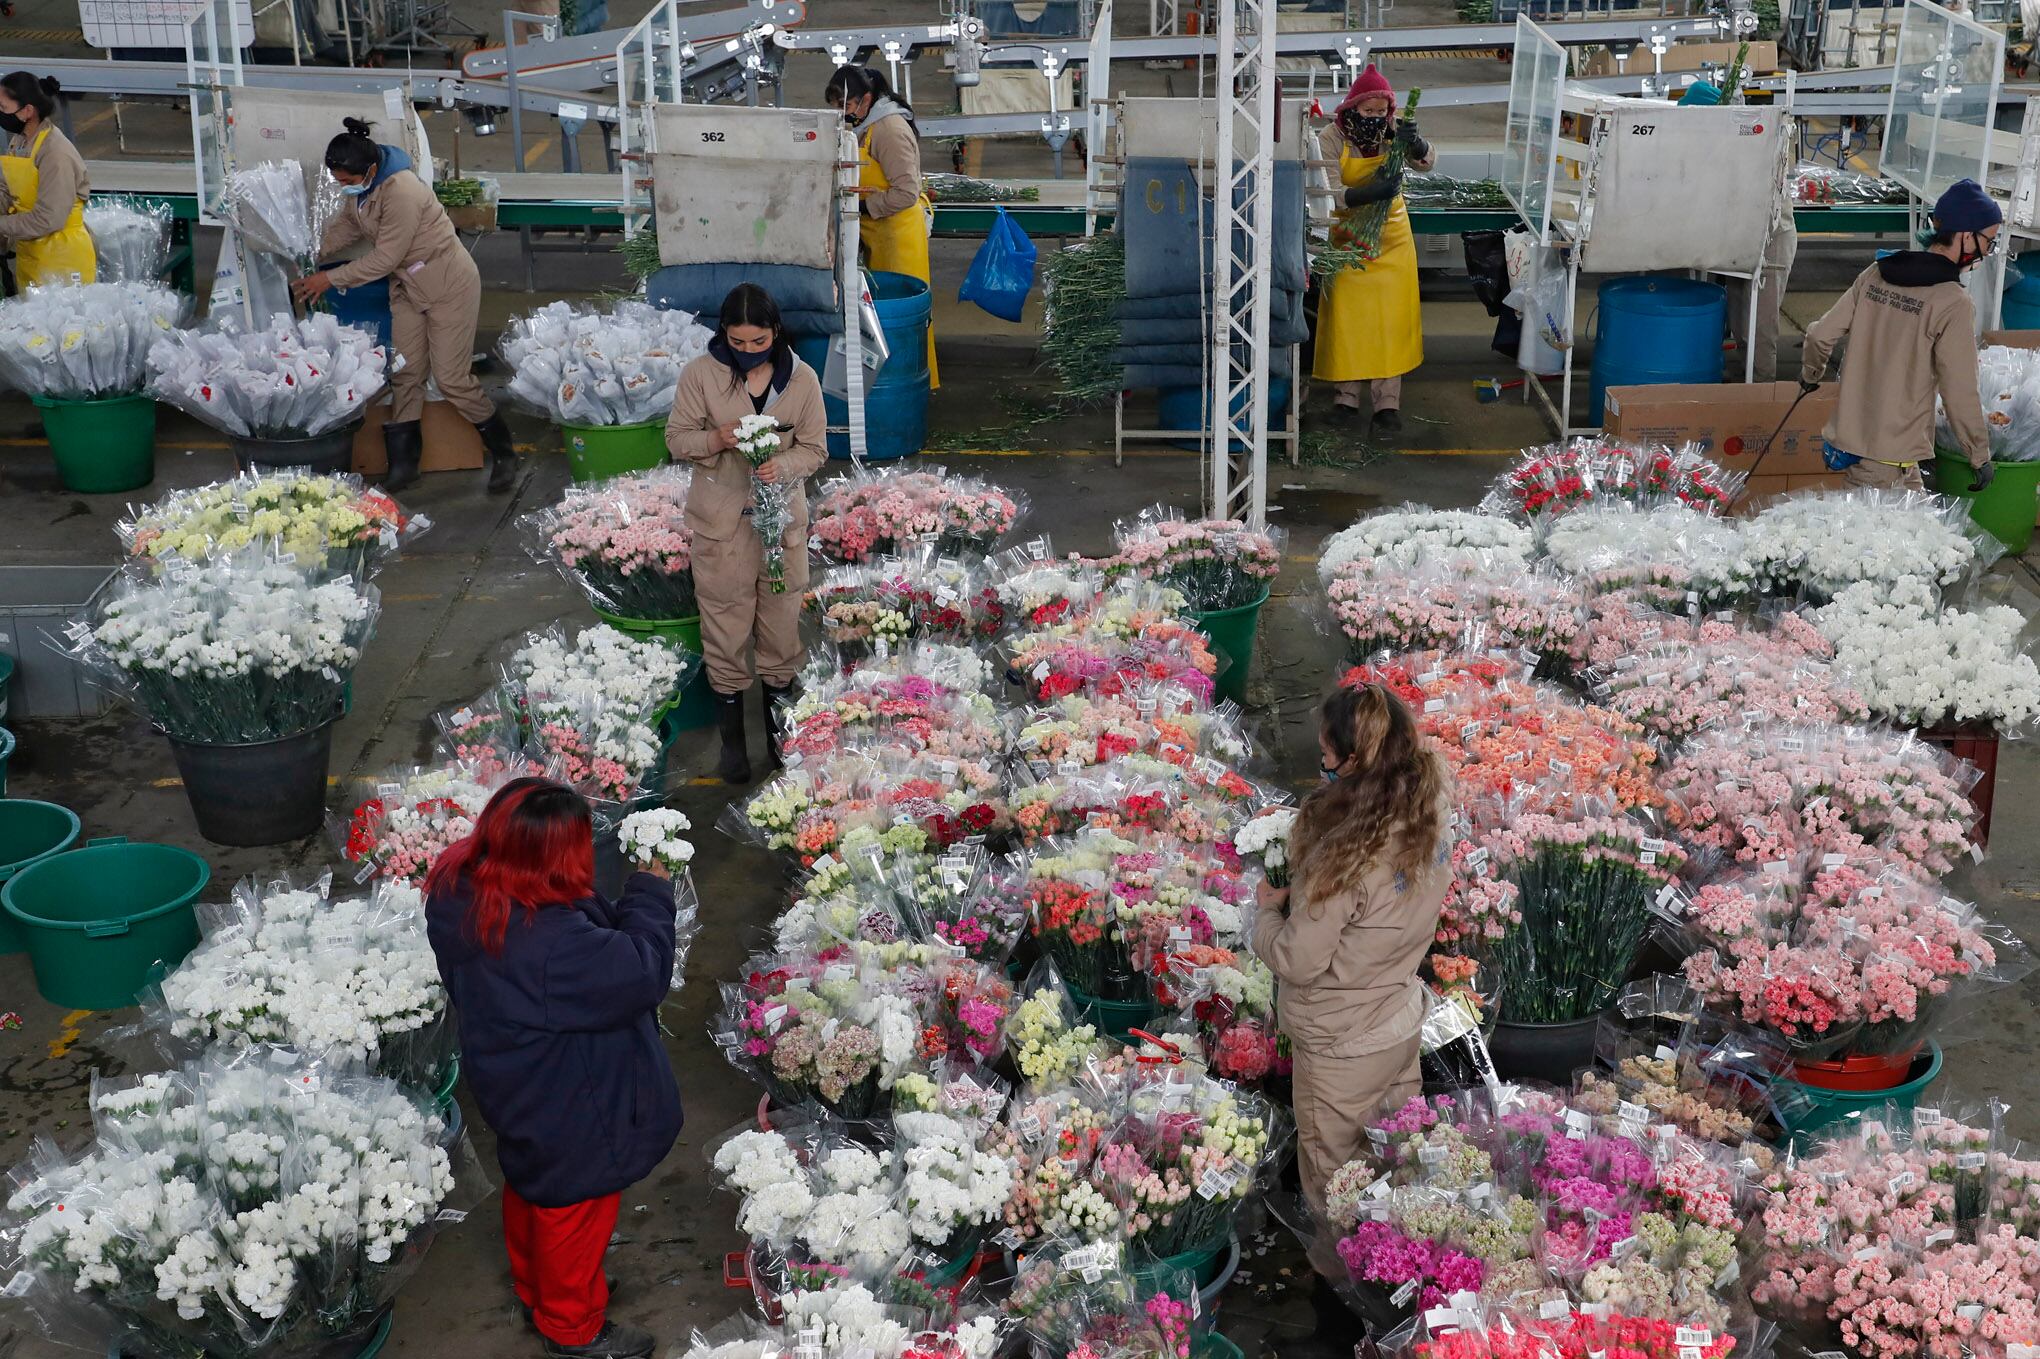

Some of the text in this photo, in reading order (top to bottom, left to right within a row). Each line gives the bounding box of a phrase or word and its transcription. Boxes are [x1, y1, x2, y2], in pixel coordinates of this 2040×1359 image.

[1632, 125, 1655, 135] 267
[701, 132, 725, 142] 362
[1146, 179, 1164, 214] C
[1865, 291, 1888, 304] TRABAJO
[1868, 284, 1889, 297] TRABAJO
[1889, 291, 1901, 300] CON
